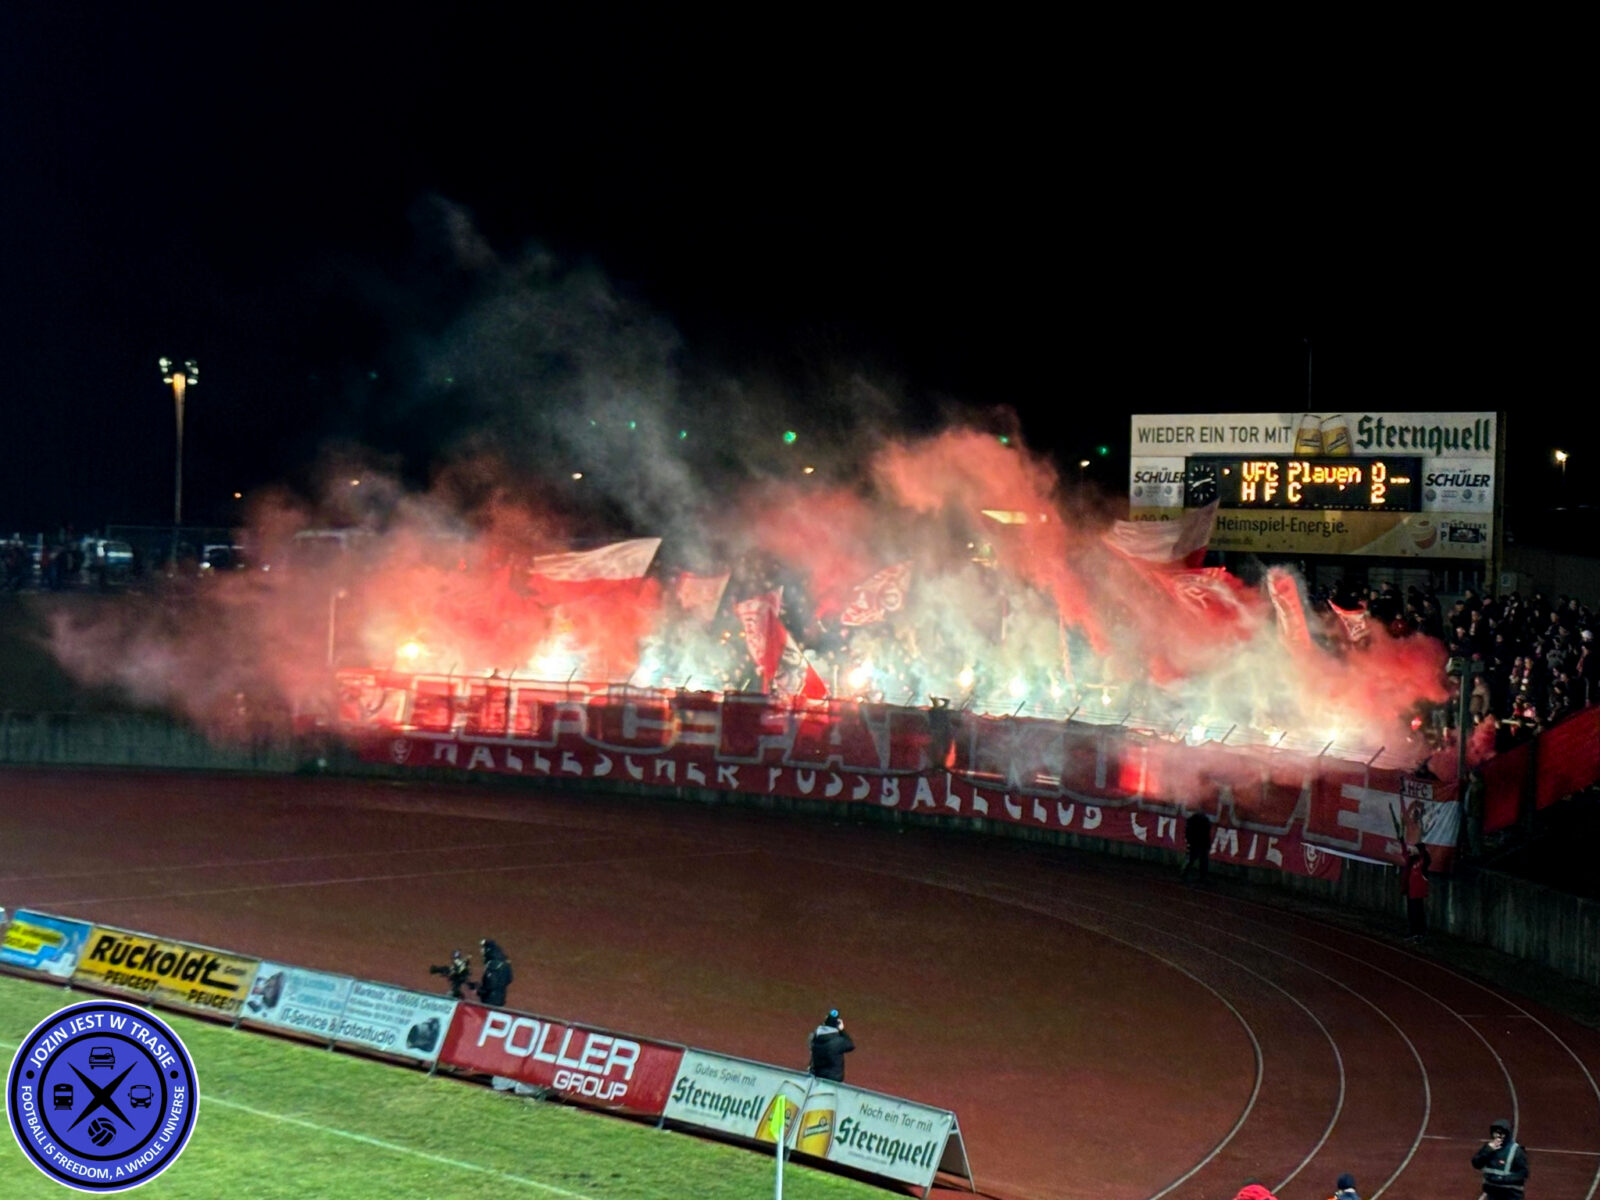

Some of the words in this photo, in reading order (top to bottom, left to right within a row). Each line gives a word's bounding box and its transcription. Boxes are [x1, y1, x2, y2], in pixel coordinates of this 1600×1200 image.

[1138, 427, 1194, 443] WIEDER
[1200, 427, 1225, 443] EIN
[1229, 426, 1260, 443] TOR
[1264, 426, 1292, 443] MIT
[1356, 414, 1490, 456] Sternquell
[1134, 467, 1186, 484] SCHÜLER
[1241, 461, 1279, 482] VFC
[1288, 461, 1362, 483] Plauen
[1425, 469, 1490, 487] SCHÜLER
[1370, 483, 1386, 504] 2
[1216, 515, 1349, 536] Heimspiel-Energie.
[1131, 811, 1284, 867] CHMIE
[89, 934, 239, 991] Rückoldt
[104, 969, 158, 991] PEUGEOT
[187, 989, 242, 1011] PEUGEOT
[281, 1008, 326, 1030] IT-Service
[337, 1018, 397, 1045] Fotostudio
[477, 1010, 641, 1080] POLLER
[552, 1069, 628, 1100] GROUP
[695, 1062, 718, 1079] Gutes
[720, 1067, 740, 1085] Spiel
[740, 1074, 757, 1087] mit
[671, 1076, 765, 1121] Sternquell
[859, 1103, 881, 1119] Noch
[883, 1109, 899, 1123] ein
[900, 1112, 916, 1127] Tor
[916, 1119, 933, 1133] mit
[834, 1116, 938, 1169] Sternquell
